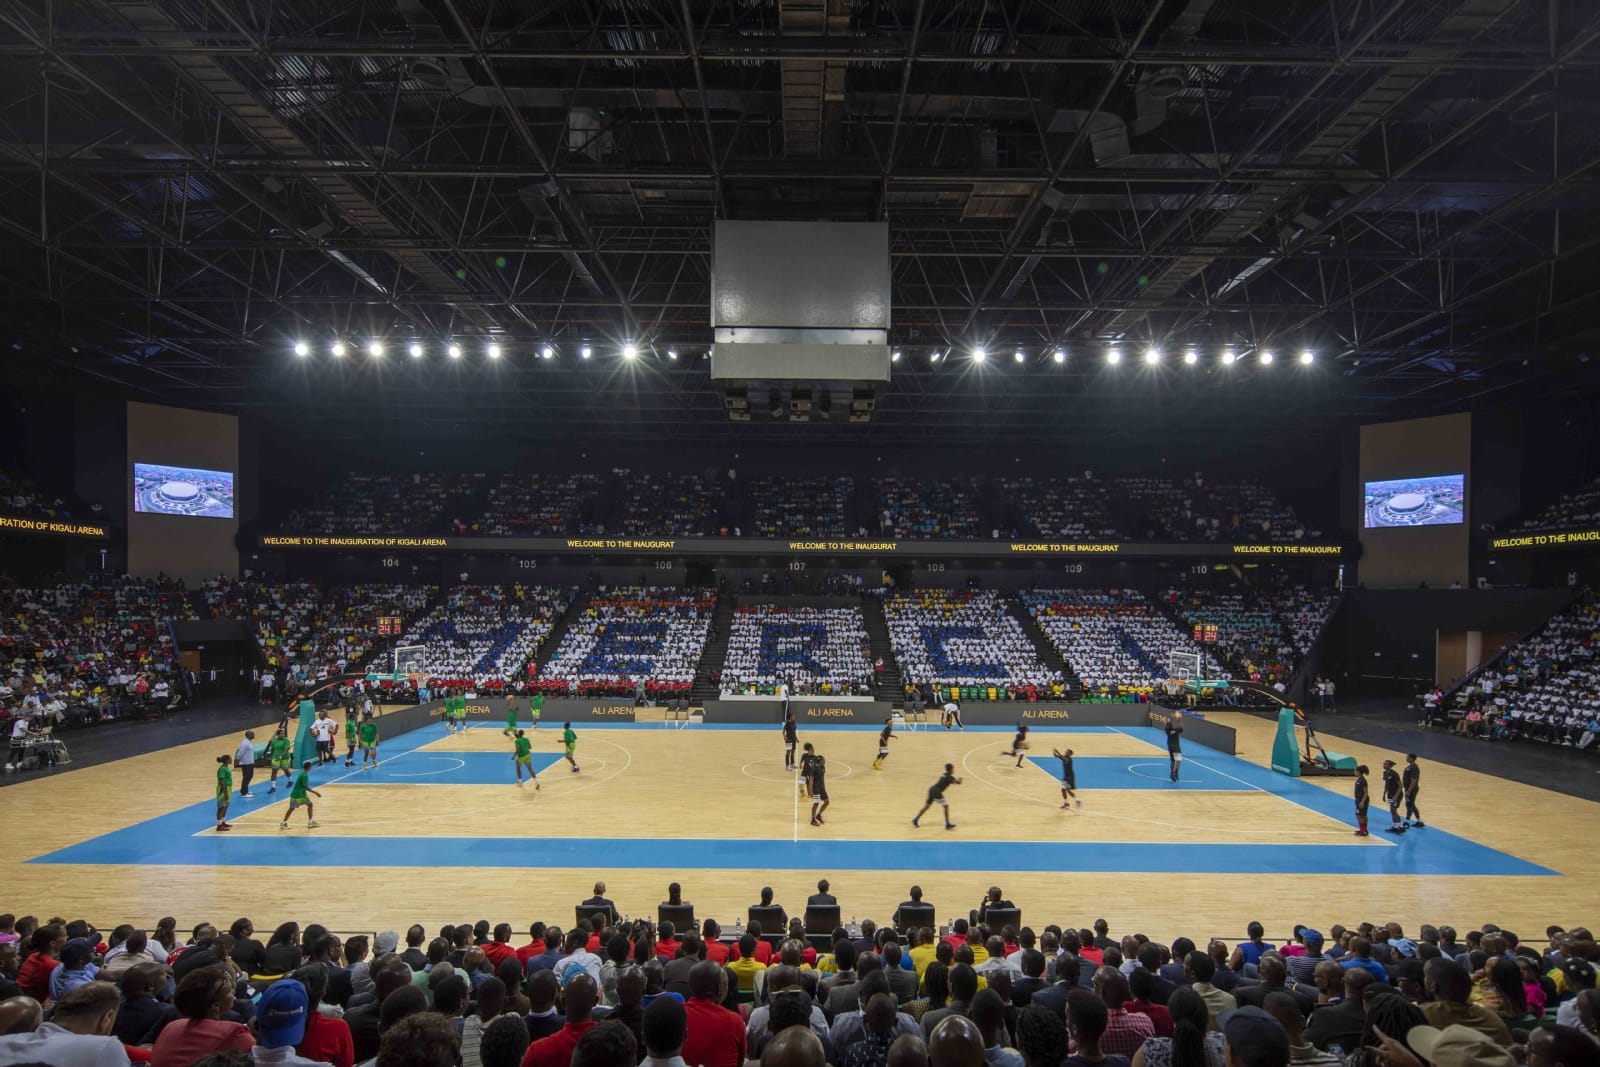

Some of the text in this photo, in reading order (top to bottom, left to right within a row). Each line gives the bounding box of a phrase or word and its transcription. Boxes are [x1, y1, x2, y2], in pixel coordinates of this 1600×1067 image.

[36, 521, 48, 530] OF
[49, 523, 76, 533] KIGALI
[77, 526, 104, 536] ARENA
[264, 537, 447, 546] WELCOME TO THE INAUGURATION OF KIGALI ARENA
[567, 540, 675, 548] WELCOME TO THE INAUGURAT
[1493, 537, 1534, 548] WELCOME
[1535, 536, 1547, 545] TO
[1548, 534, 1566, 543] THE
[789, 542, 897, 550] WELCOME TO THE INAUGURAT
[1011, 544, 1119, 552] WELCOME TO THE INAUGURAT
[1233, 545, 1342, 553] WELCOME TO THE INAUGURAT
[382, 558, 399, 567] 104
[519, 560, 537, 569] 105
[655, 561, 672, 570] 106
[789, 562, 806, 571] 107
[927, 564, 945, 572] 108
[1065, 564, 1082, 573] 109
[1191, 565, 1208, 574] 110
[465, 705, 491, 714] RENA
[591, 706, 606, 715] ALI
[807, 708, 854, 717] ALI ARENA
[1022, 710, 1069, 719] ALI ARENA
